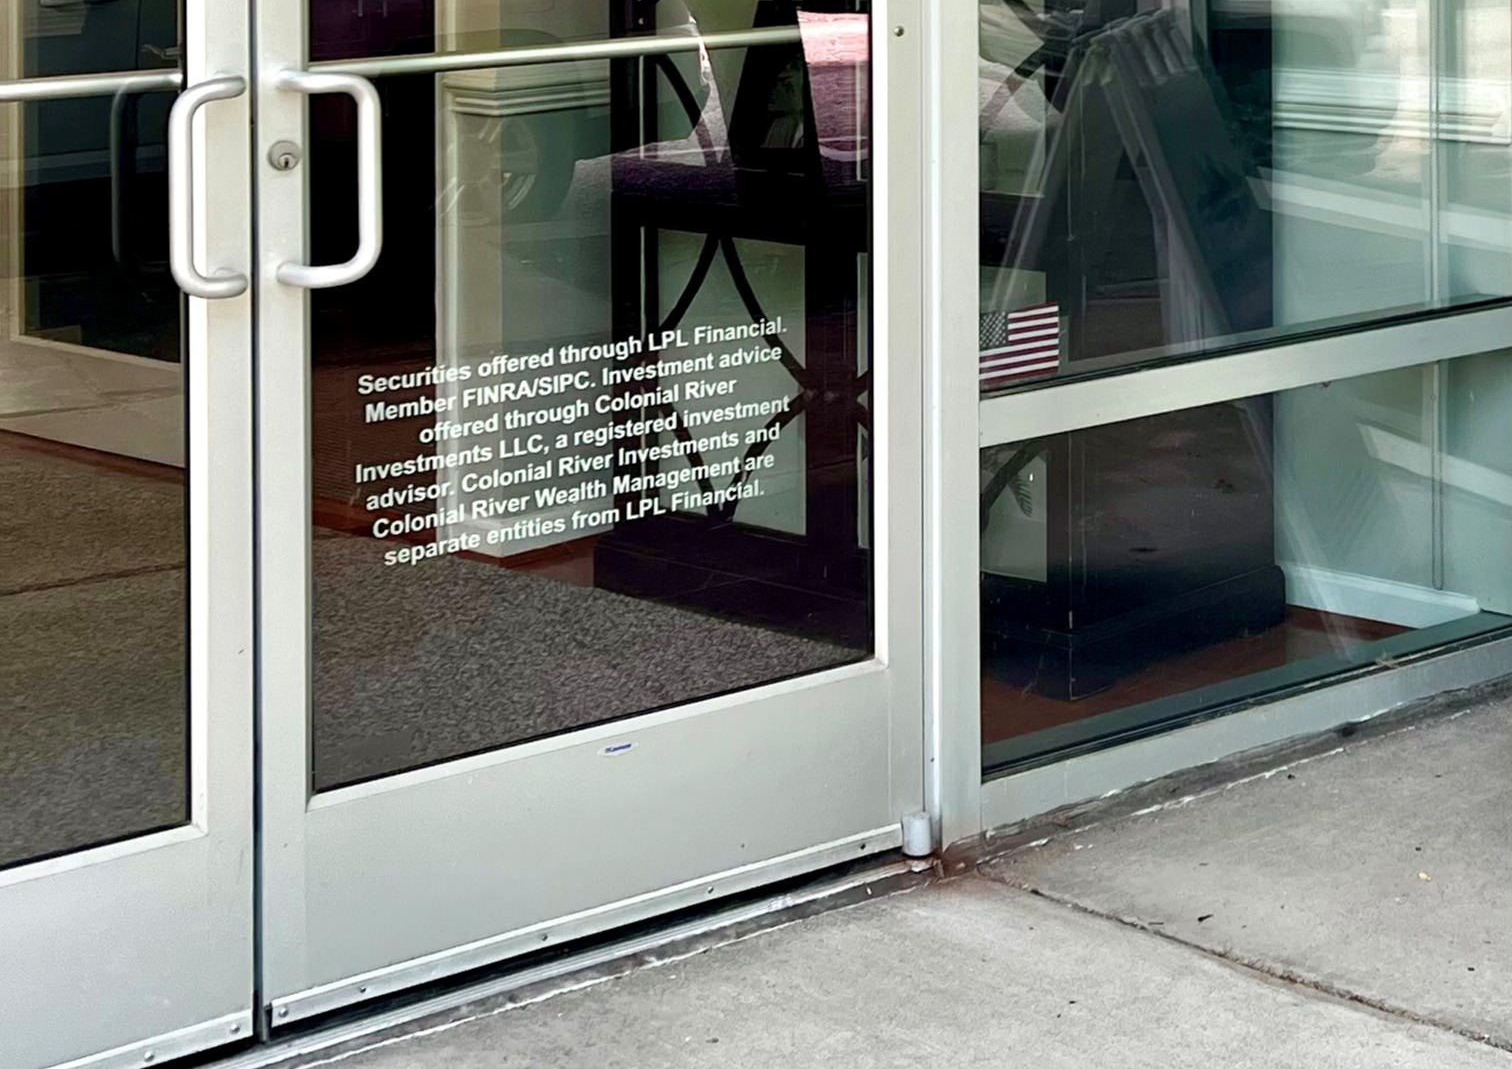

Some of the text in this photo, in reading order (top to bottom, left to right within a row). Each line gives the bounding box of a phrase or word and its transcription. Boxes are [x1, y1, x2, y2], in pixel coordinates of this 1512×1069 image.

[357, 316, 787, 395] Securities offered through LPL Financial.
[365, 345, 782, 423] Member FINRA/SIPC. Investment advice
[355, 395, 790, 483] Investments LLC, a registered investment
[418, 379, 737, 443] offered through Colonial River
[365, 422, 780, 511] advisor. Colonial River Investments and
[372, 453, 776, 538] Colonial River Wealth Management are
[384, 479, 764, 567] separate entities from LPL Financial.
